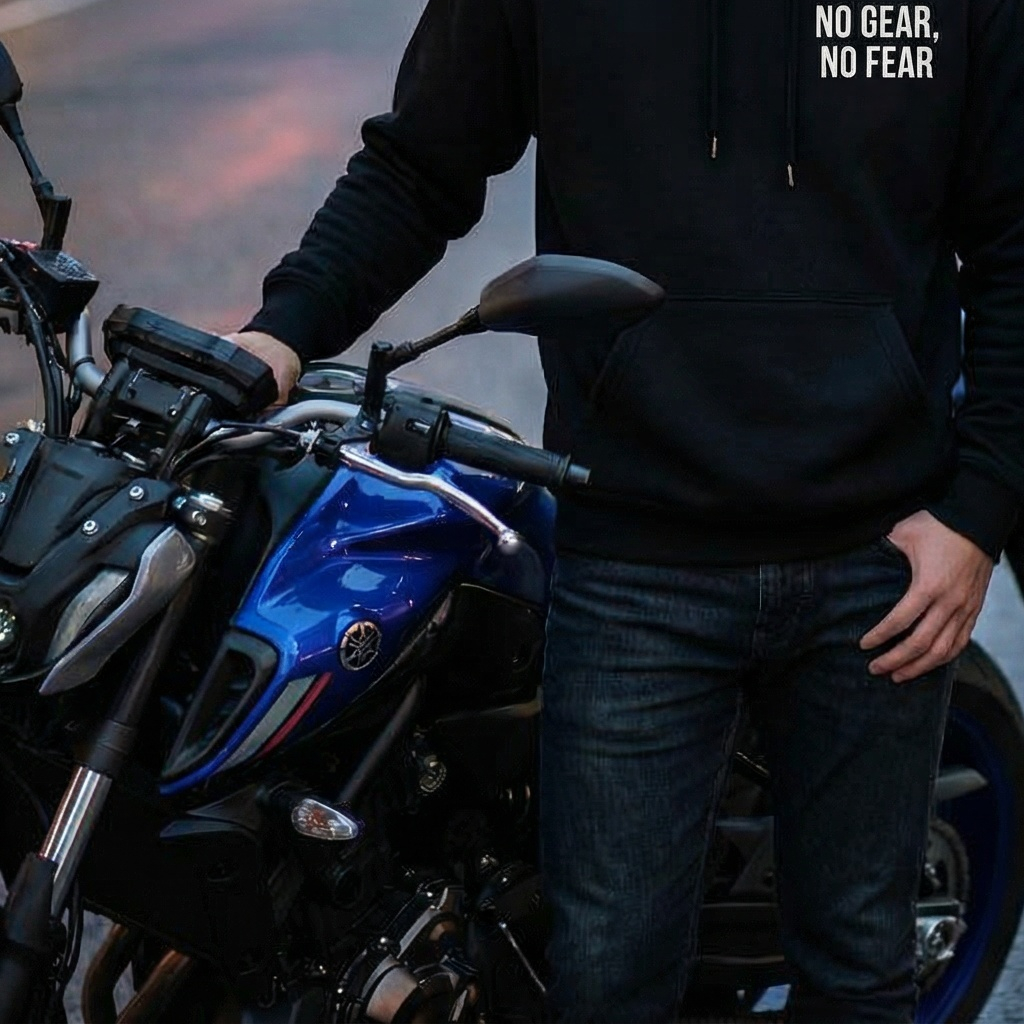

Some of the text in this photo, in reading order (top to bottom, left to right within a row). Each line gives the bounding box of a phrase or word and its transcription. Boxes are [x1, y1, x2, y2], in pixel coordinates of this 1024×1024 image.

[815, 5, 939, 43] NO GEAR,
[820, 45, 933, 78] NO FEAR
